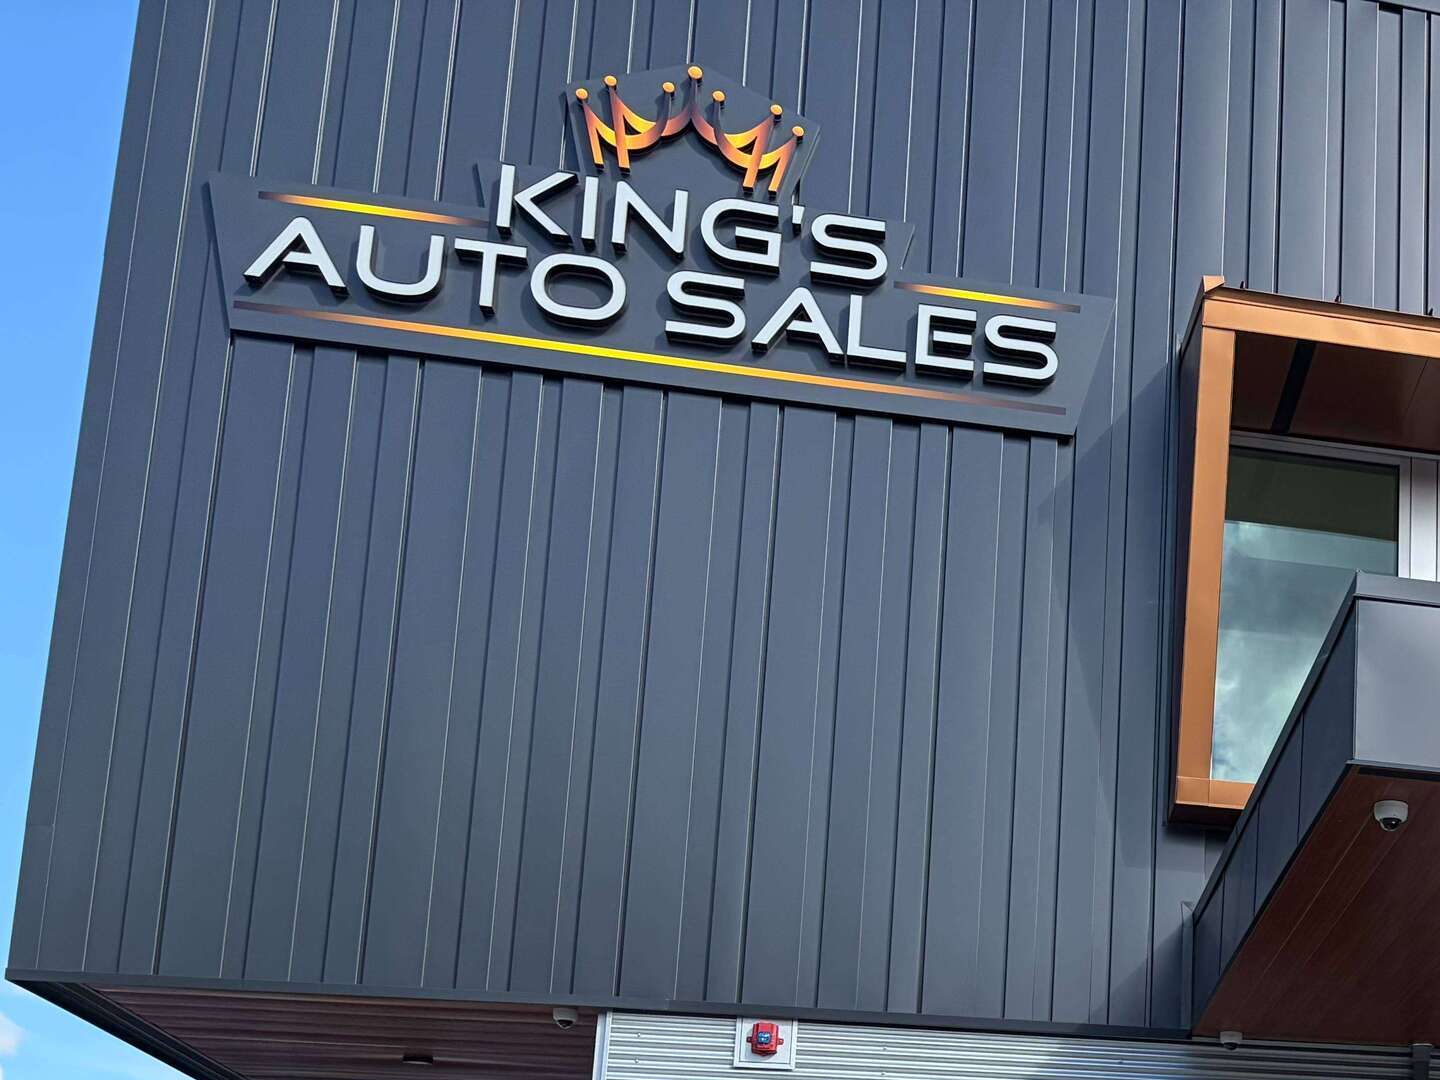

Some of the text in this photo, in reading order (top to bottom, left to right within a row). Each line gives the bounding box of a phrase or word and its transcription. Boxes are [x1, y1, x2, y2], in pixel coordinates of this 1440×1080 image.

[495, 163, 889, 286] KING'S
[242, 215, 1060, 385] AUTO SALES
